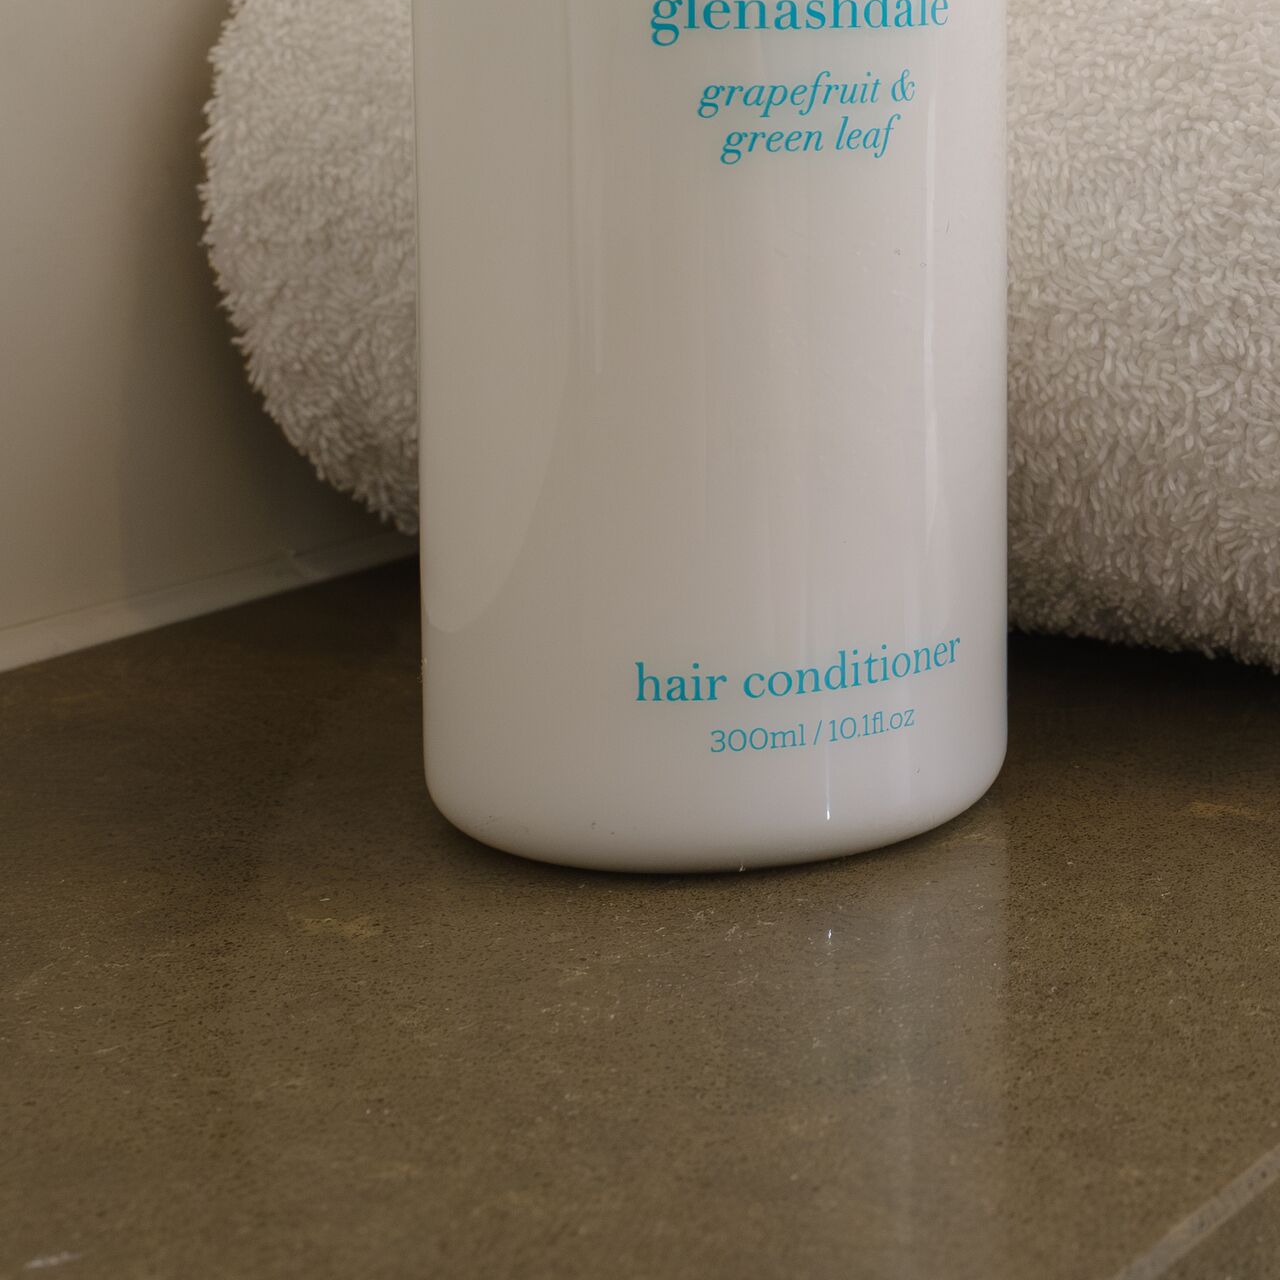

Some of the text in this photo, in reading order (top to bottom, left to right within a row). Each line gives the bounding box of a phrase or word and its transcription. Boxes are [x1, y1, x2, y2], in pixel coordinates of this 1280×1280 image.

[697, 69, 916, 118] grapefruit &
[720, 114, 902, 166] green leaf
[635, 636, 960, 702] hair conditioner
[709, 723, 806, 753] 300ml
